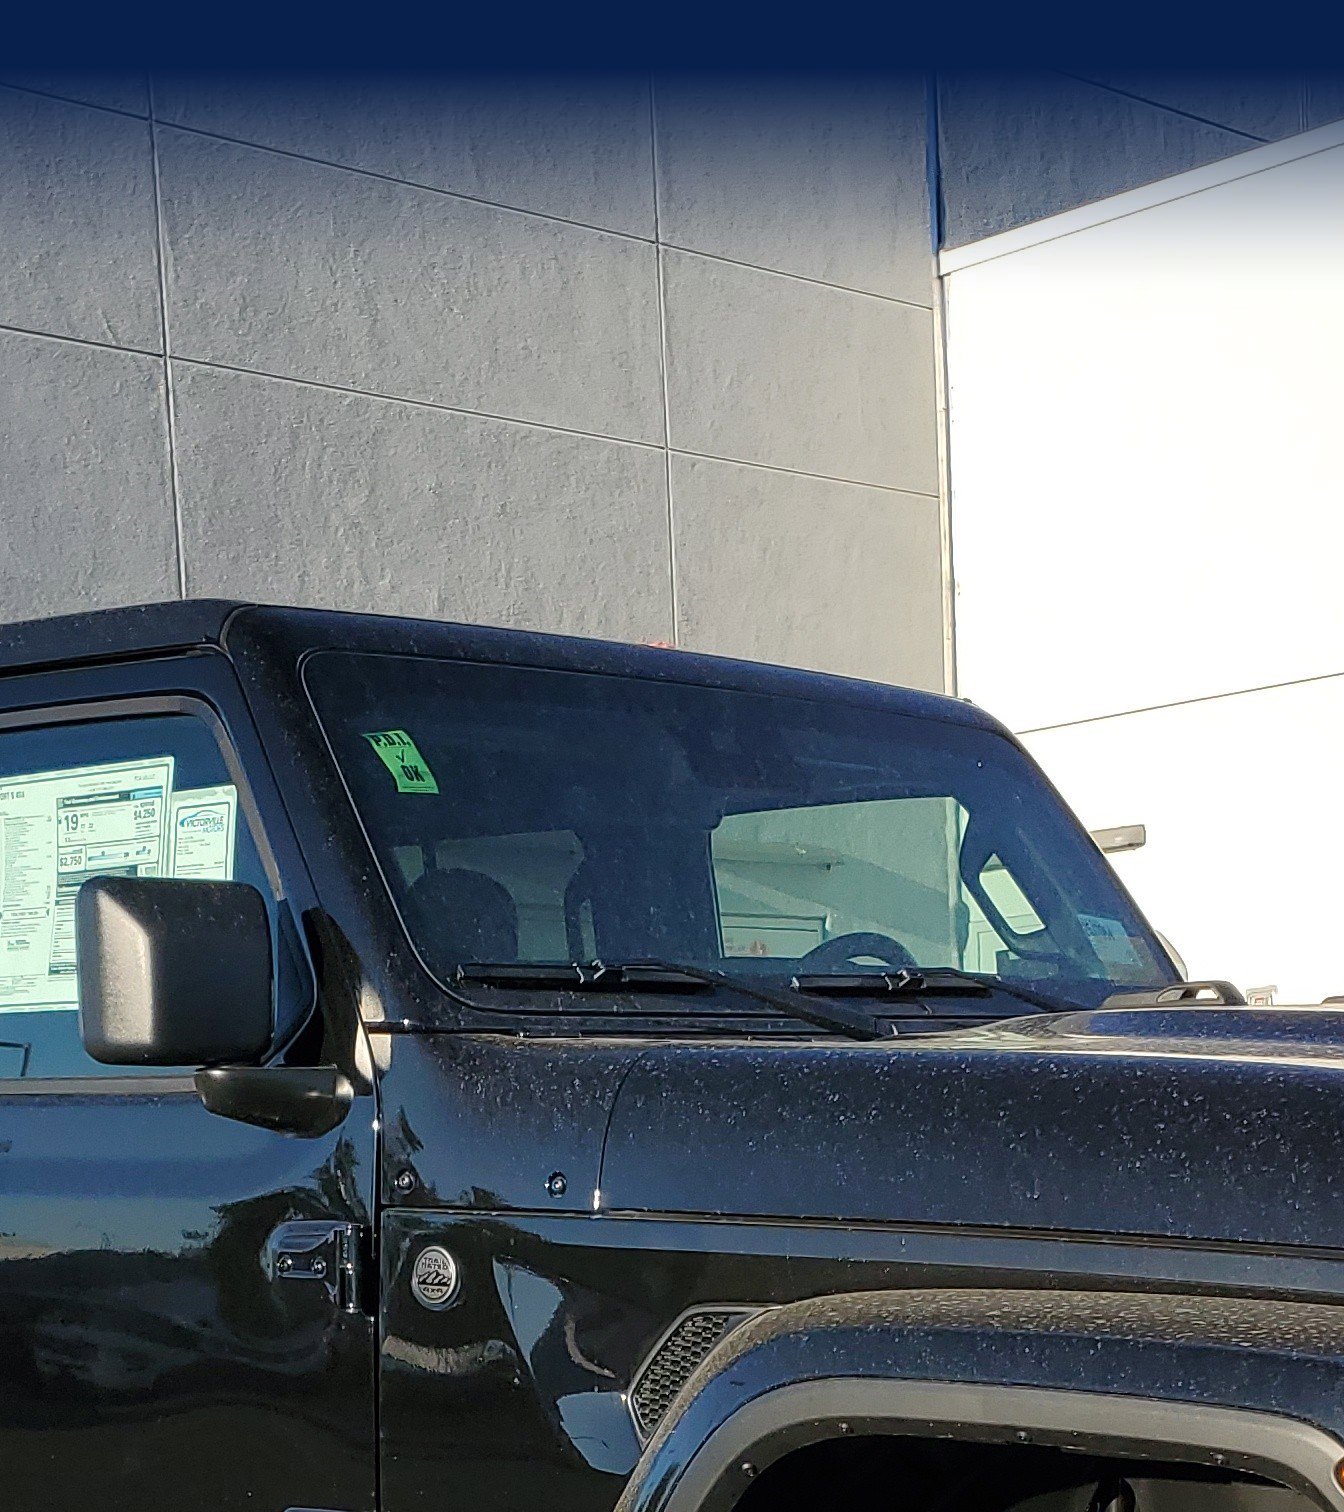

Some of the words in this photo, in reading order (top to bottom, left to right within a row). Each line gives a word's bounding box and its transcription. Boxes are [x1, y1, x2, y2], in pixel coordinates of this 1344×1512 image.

[370, 733, 413, 748] P.D.I.
[400, 765, 426, 782] OK
[64, 813, 79, 832] 19
